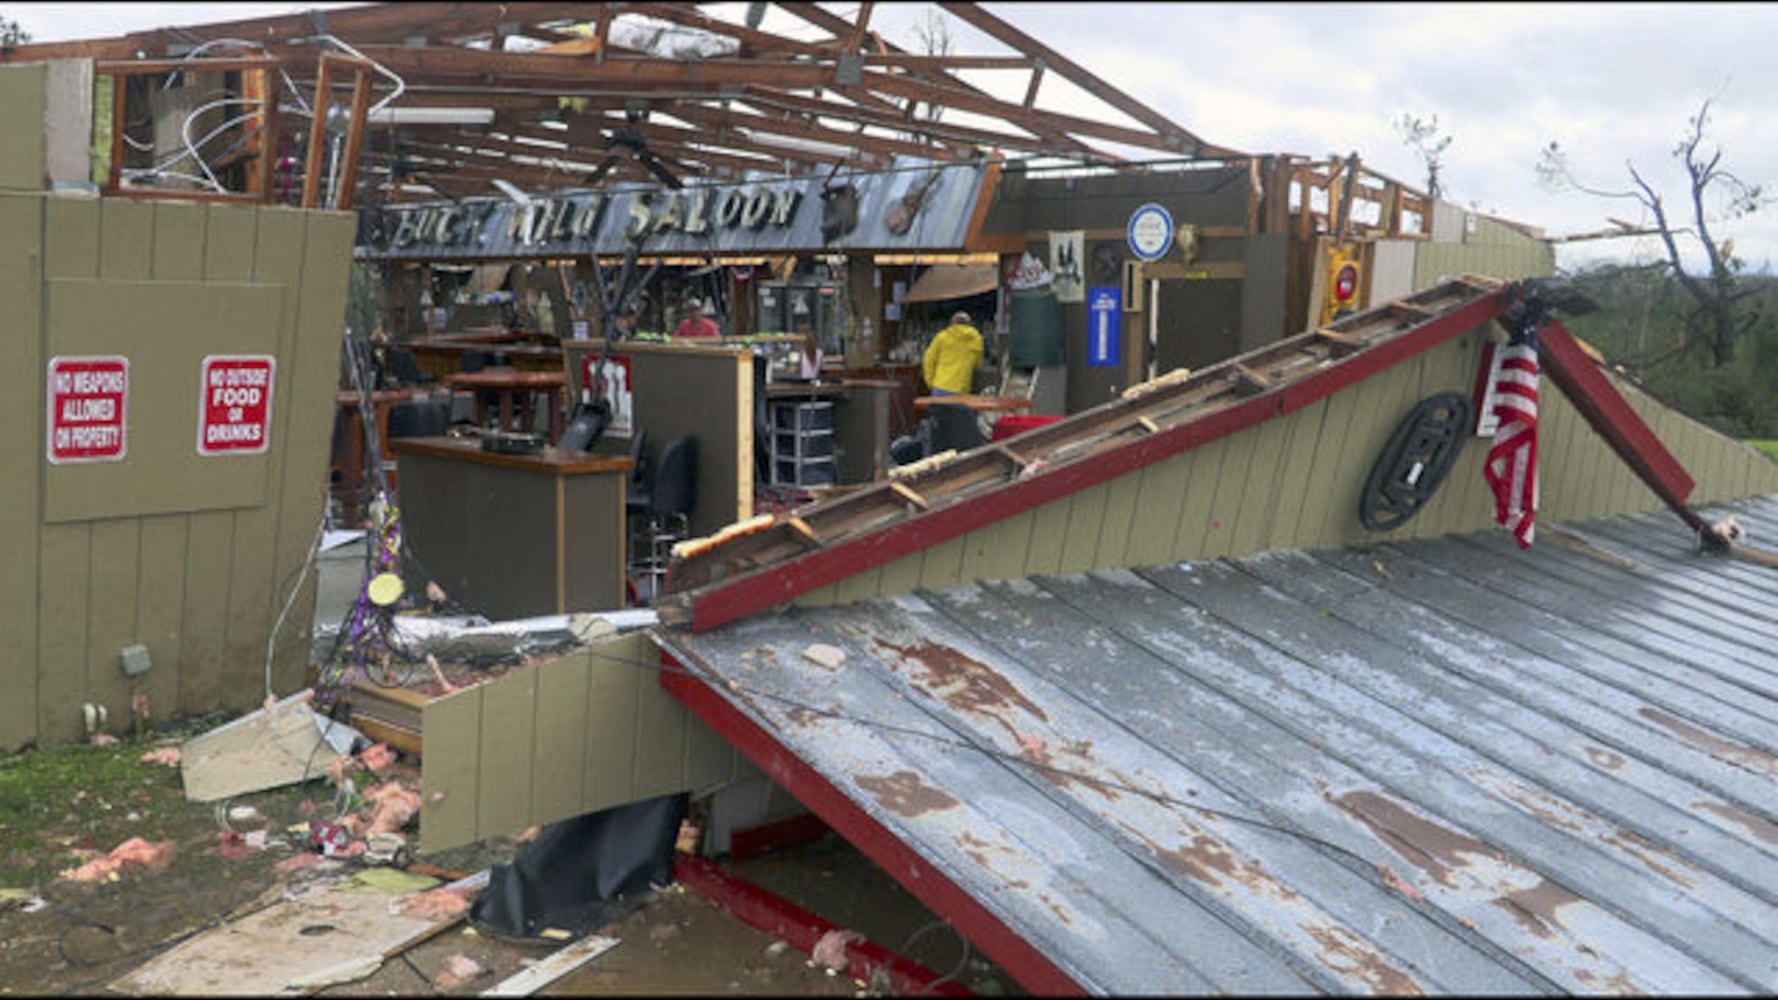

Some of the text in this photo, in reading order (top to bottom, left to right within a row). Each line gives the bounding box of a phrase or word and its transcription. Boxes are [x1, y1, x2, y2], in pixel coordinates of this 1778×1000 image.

[626, 186, 801, 239] SALOON
[54, 371, 124, 394] NO WEAPONS
[210, 368, 267, 386] NO OUTSIDE
[213, 387, 261, 407] FOOD
[63, 398, 115, 421] ALLOWED
[229, 407, 243, 423] OR
[57, 425, 118, 449] ON PROPERTY
[207, 424, 261, 443] DRINKS
